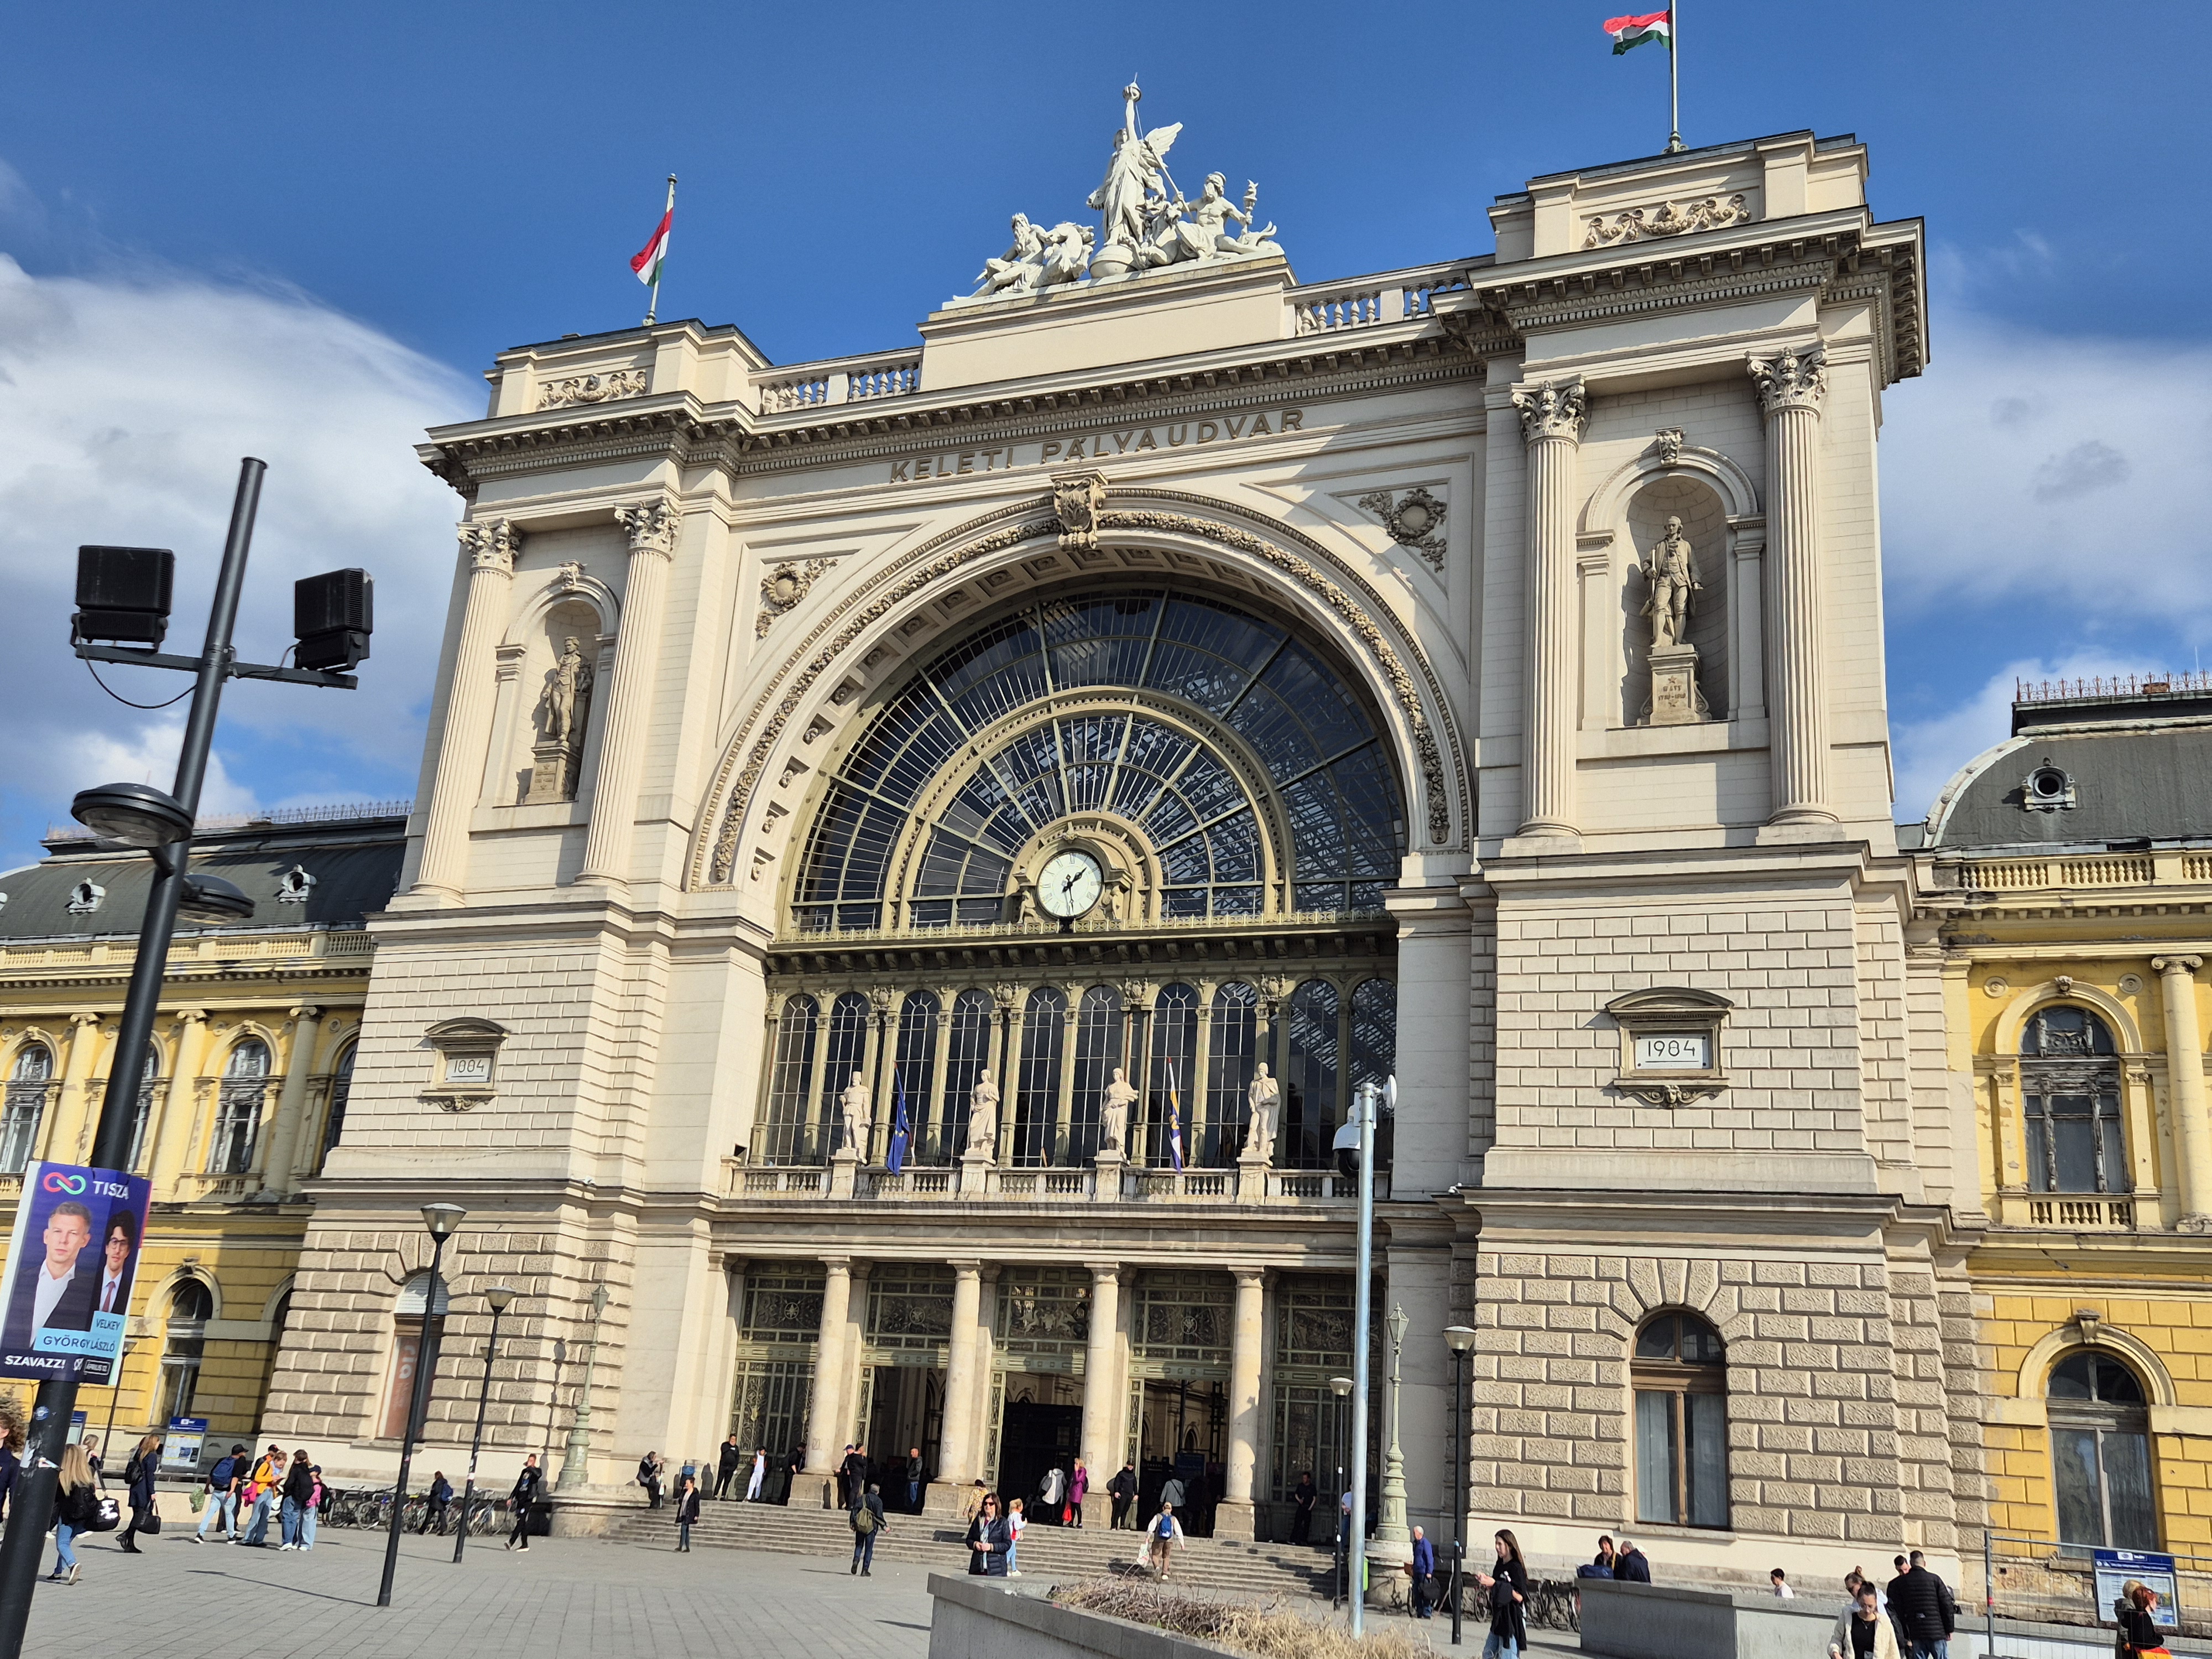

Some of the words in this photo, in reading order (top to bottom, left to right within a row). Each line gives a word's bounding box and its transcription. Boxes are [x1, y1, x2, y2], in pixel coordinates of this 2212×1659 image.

[890, 446, 1014, 483] KELETI
[1040, 409, 1305, 464] PÁLYAUDVAR
[1647, 1040, 1695, 1057] 1984
[453, 1059, 484, 1073] 1884
[92, 1181, 129, 1200] TISZA
[96, 1318, 121, 1331] VELKEY
[43, 1334, 90, 1348] GYÖRGY
[90, 1338, 116, 1352] LÁSZLÓ
[4, 1355, 66, 1369] SZAVAZZ!
